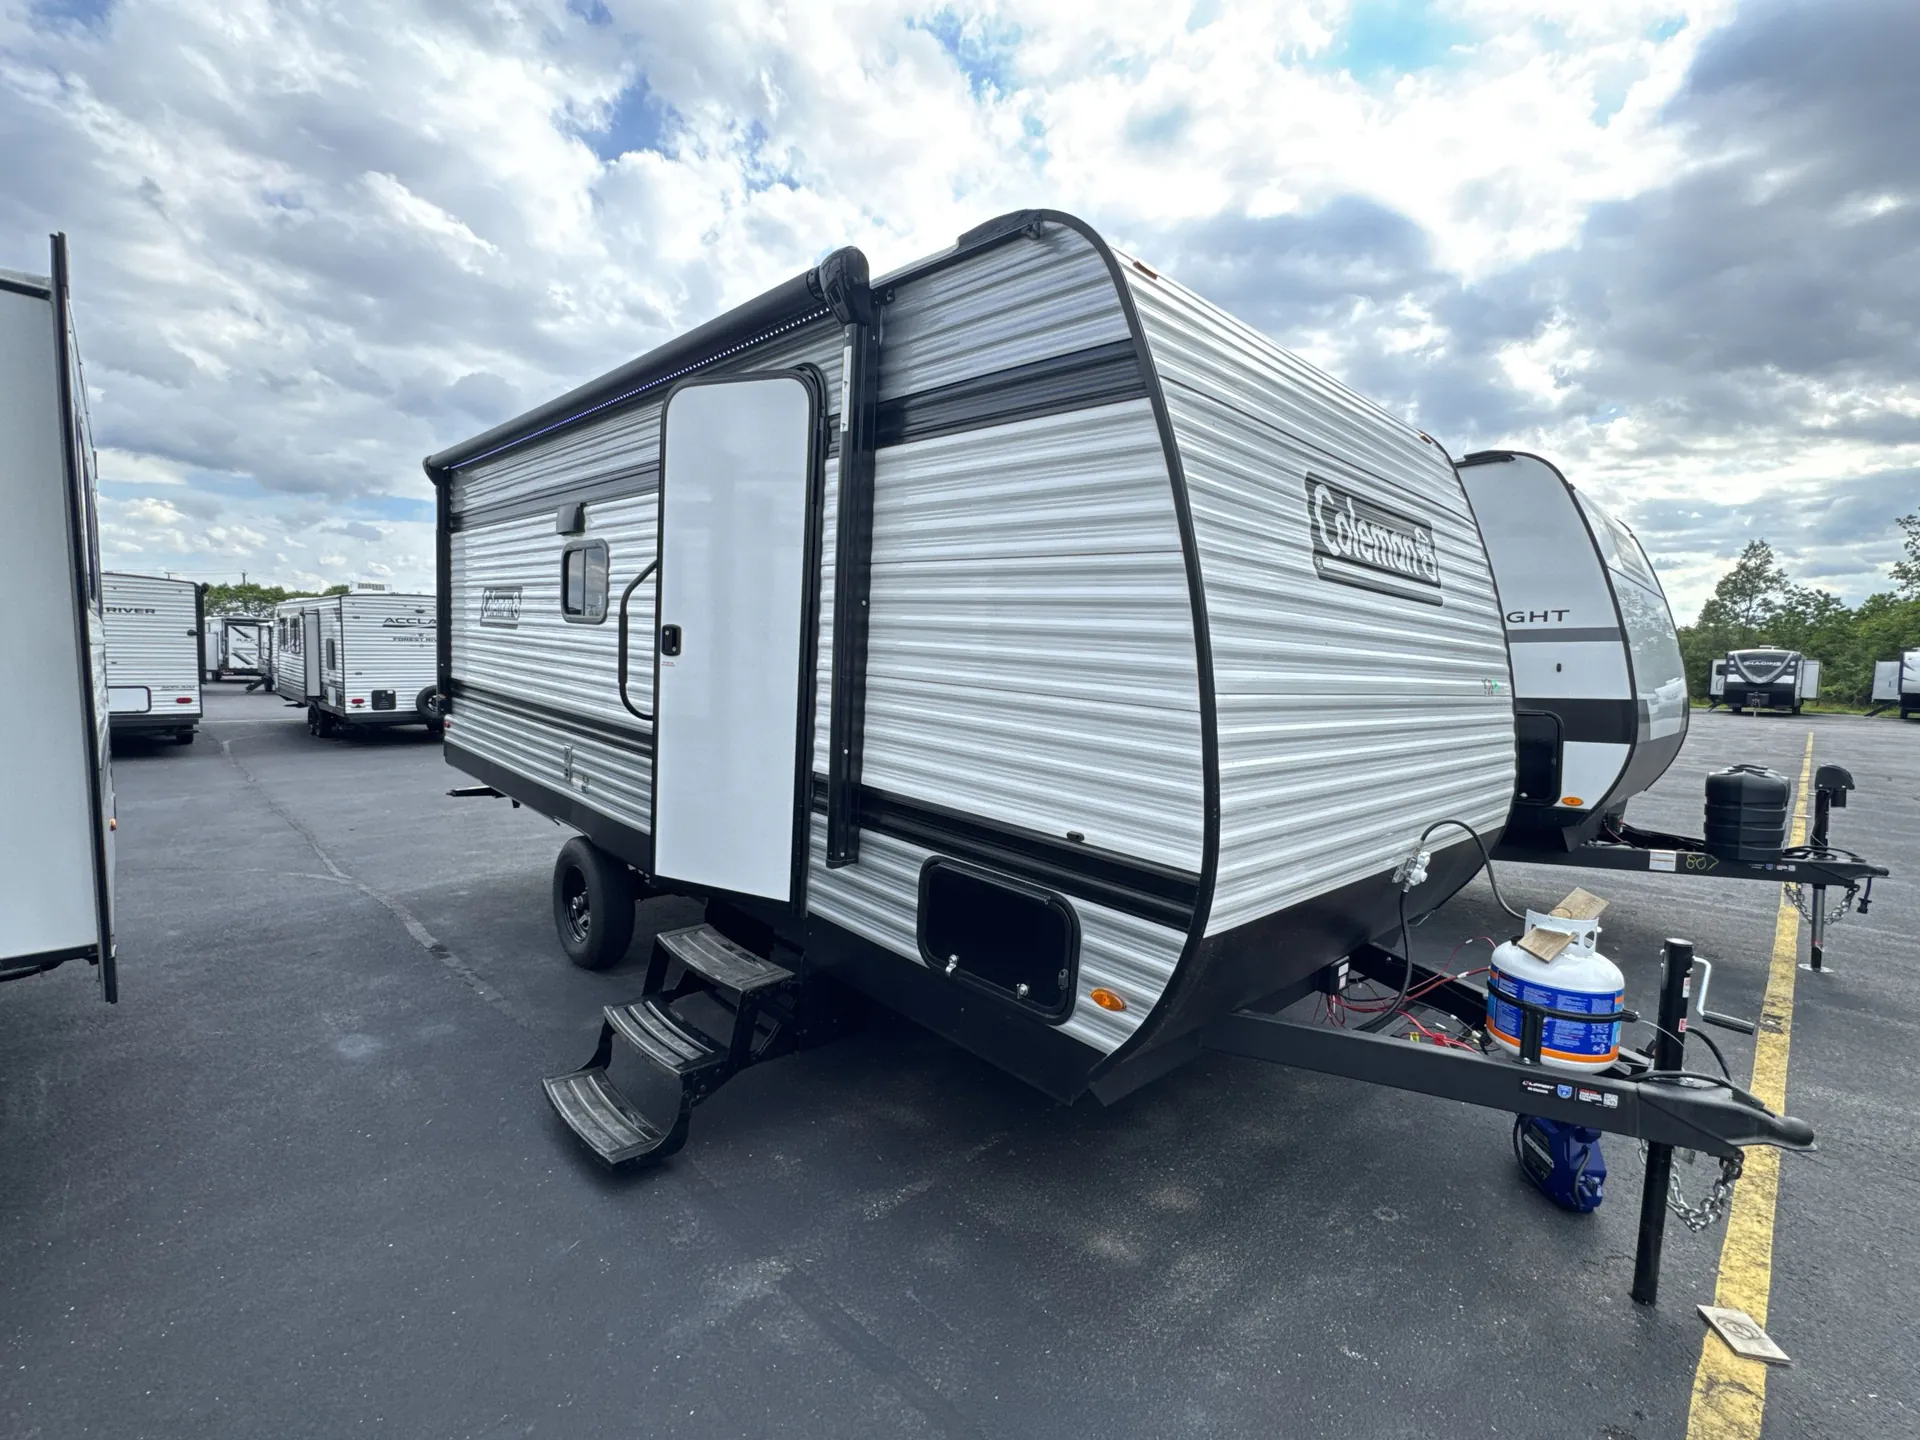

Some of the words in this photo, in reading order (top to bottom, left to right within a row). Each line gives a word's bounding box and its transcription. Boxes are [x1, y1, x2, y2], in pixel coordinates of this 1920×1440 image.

[1314, 484, 1421, 576] Coleman
[483, 590, 513, 618] Coleman
[1506, 609, 1570, 623] GHT
